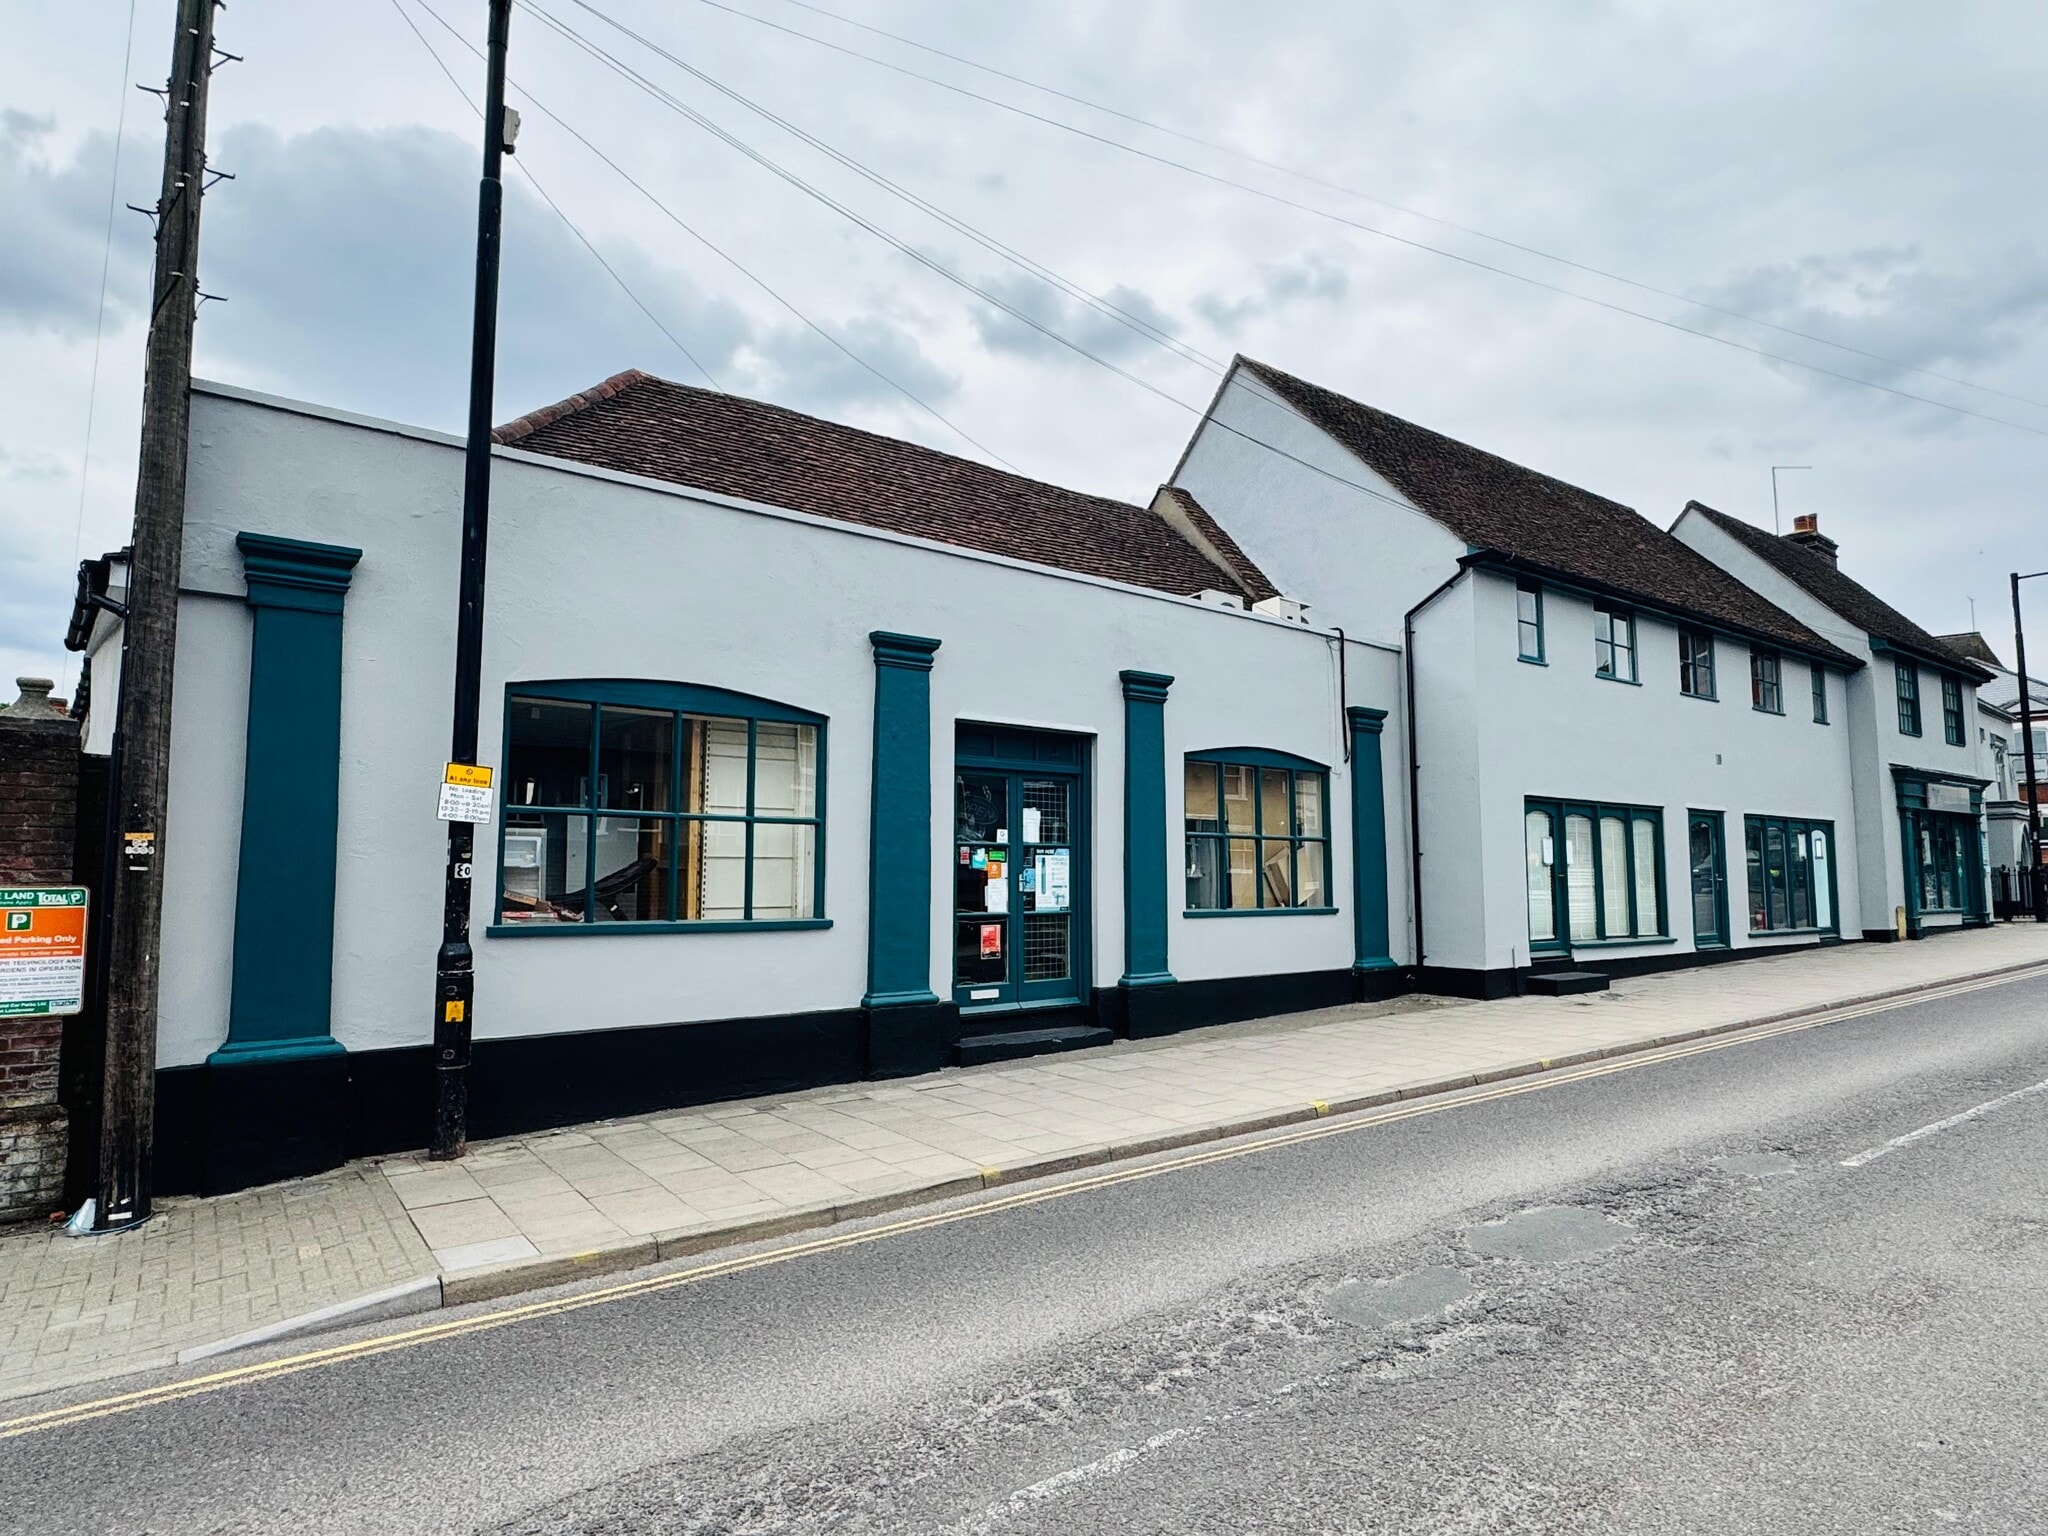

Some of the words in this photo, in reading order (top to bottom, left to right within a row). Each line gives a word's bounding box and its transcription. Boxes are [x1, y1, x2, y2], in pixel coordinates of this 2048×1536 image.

[4, 892, 35, 900] LAND
[36, 891, 69, 905] TOTAL
[14, 935, 52, 944] Parking
[54, 934, 77, 944] Only
